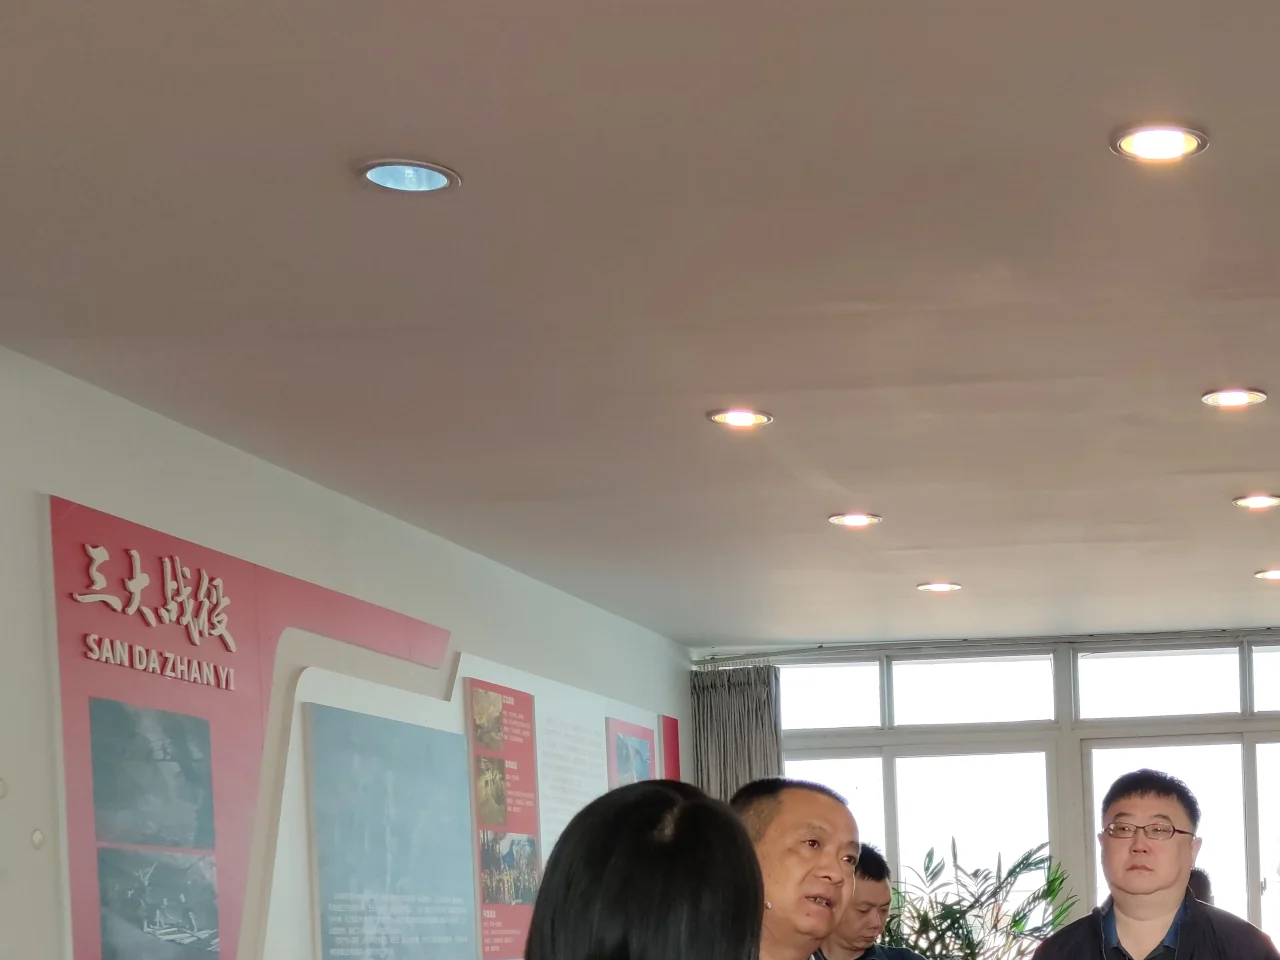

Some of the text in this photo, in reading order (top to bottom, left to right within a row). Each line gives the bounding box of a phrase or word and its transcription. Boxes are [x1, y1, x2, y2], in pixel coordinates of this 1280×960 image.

[72, 543, 236, 652] 三大战役
[86, 633, 235, 690] SAN DA ZHAN YI
